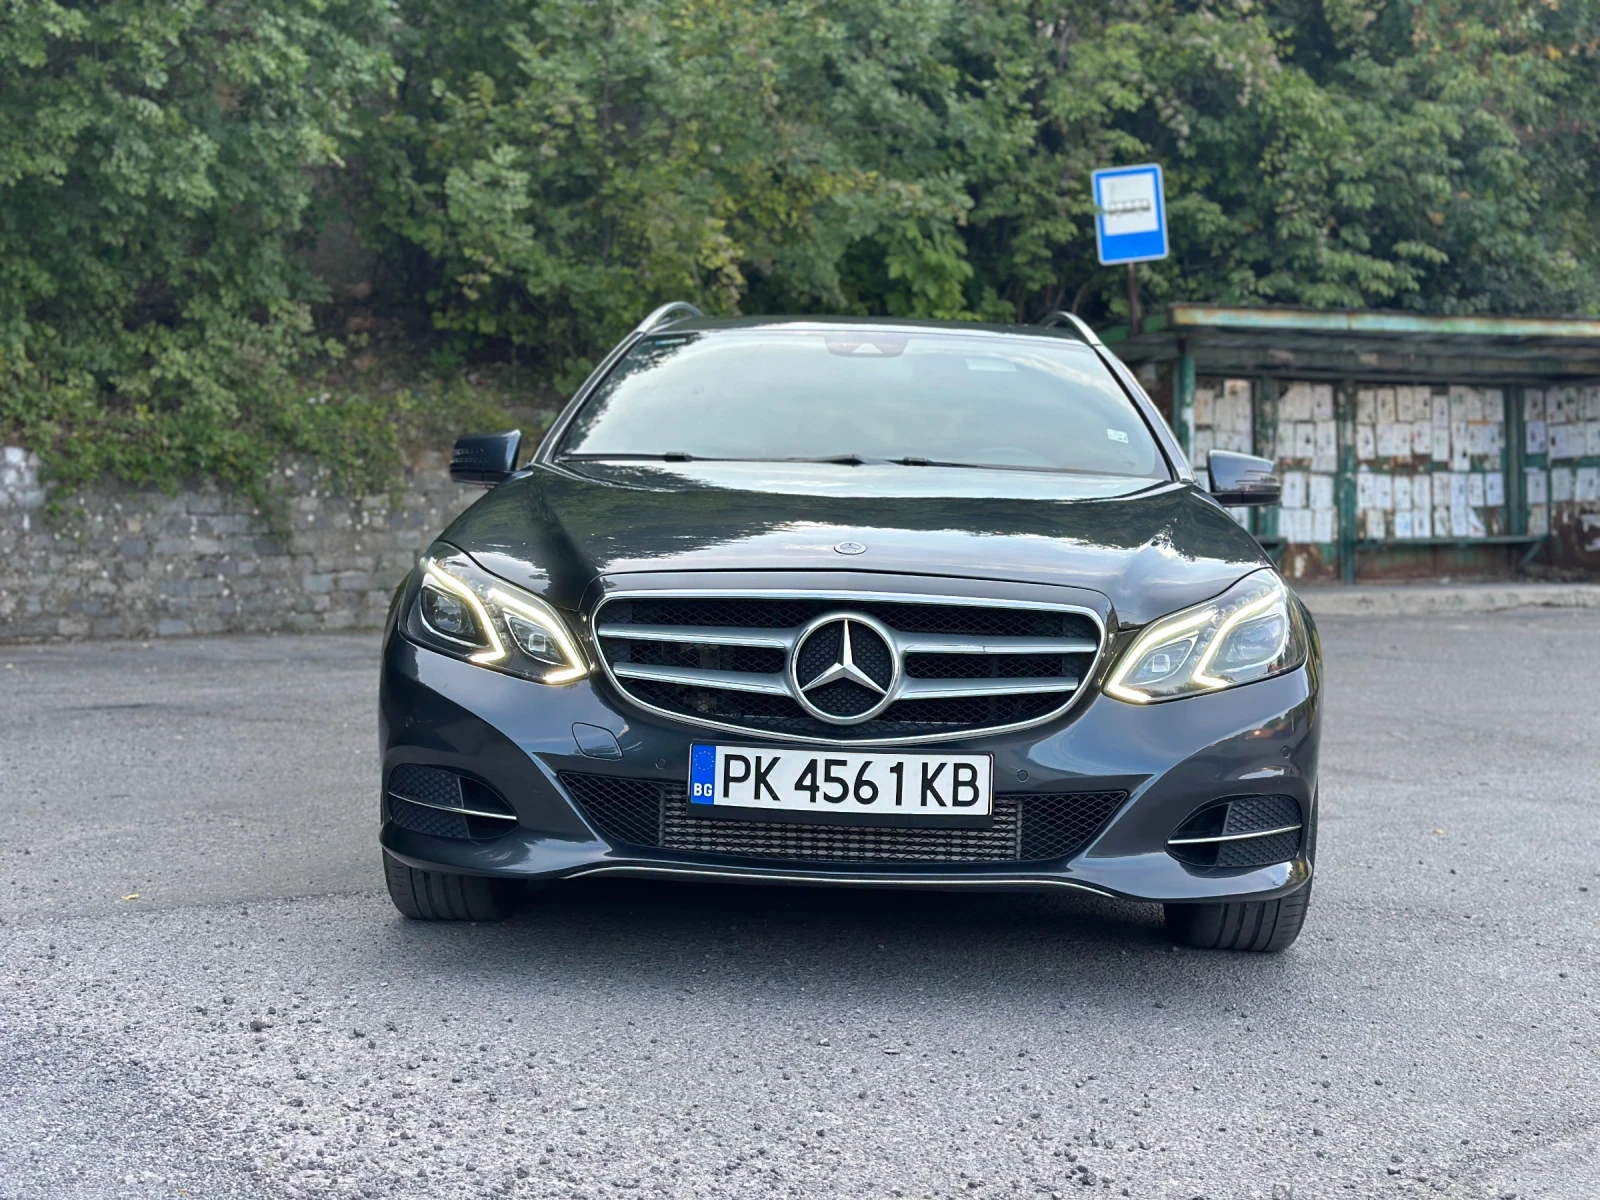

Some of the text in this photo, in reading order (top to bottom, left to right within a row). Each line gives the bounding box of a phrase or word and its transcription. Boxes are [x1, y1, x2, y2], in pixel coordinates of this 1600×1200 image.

[694, 782, 713, 797] BG
[722, 753, 980, 807] PK 4561 KB
